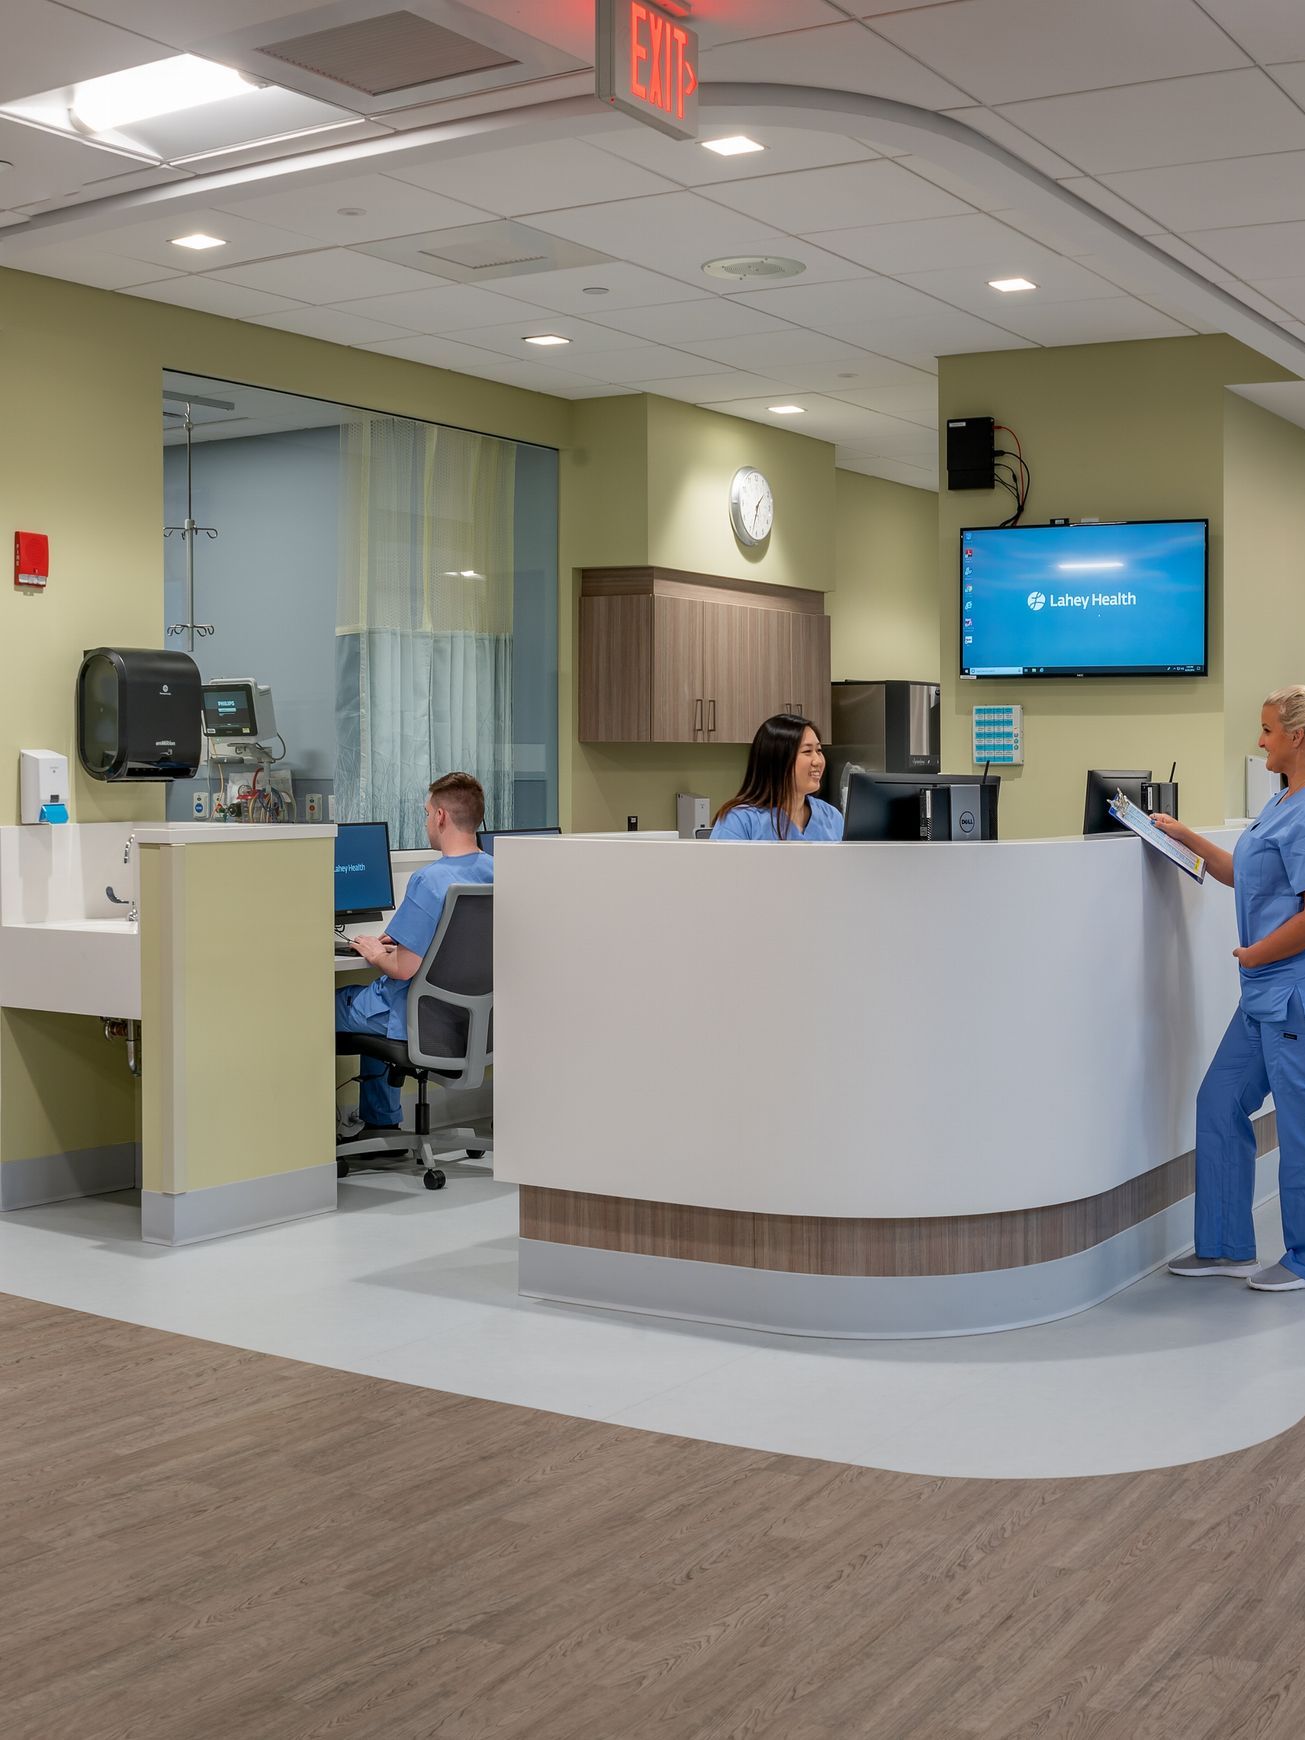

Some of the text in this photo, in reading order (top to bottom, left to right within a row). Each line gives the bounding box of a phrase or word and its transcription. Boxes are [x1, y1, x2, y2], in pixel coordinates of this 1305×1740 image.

[631, 1, 688, 120] EXIT
[1050, 592, 1137, 609] Lahey Health
[348, 863, 366, 871] Health
